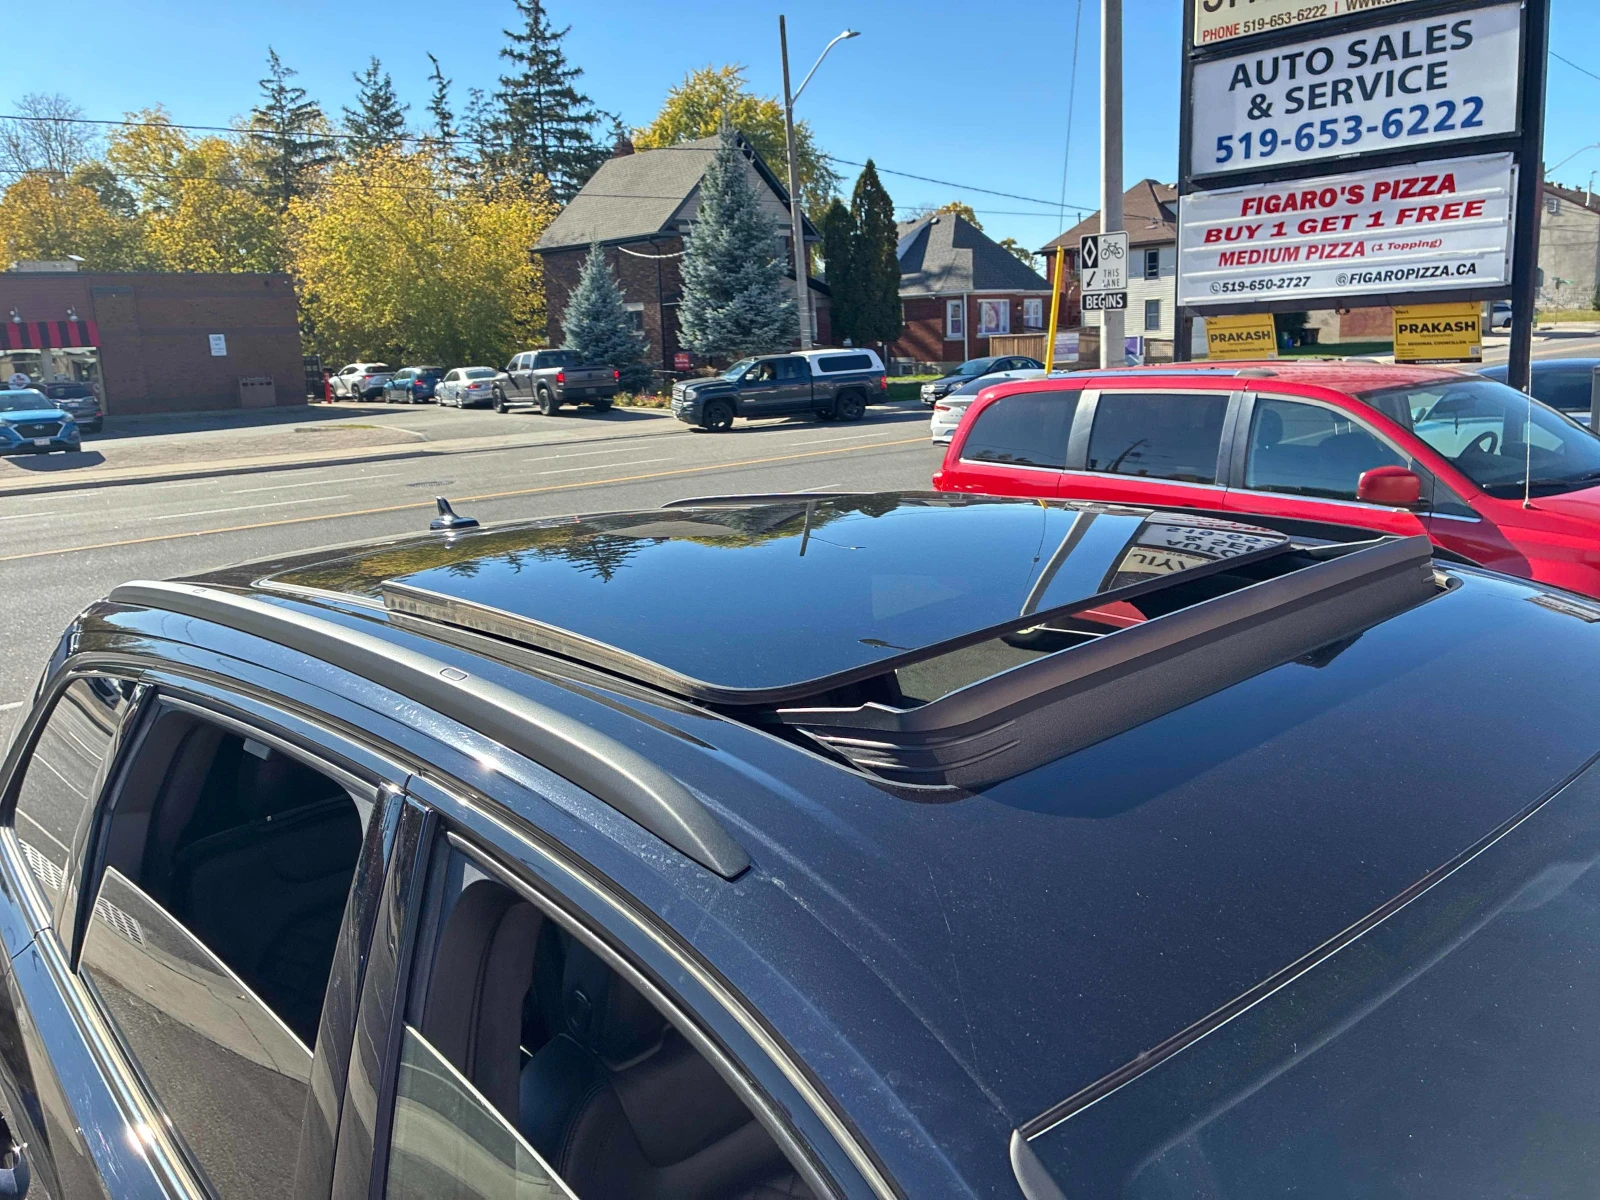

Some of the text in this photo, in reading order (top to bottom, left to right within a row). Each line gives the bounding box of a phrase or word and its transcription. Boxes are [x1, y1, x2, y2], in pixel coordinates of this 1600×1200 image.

[1202, 23, 1240, 42] PHONE
[1243, 4, 1327, 33] 519-653-6222
[1228, 20, 1473, 91] AUTO SALES
[1247, 60, 1448, 120] & SERVICE
[1215, 96, 1484, 163] 519-653-6222
[1241, 173, 1456, 216] FIGARO'S PIZZA
[1204, 199, 1486, 244] BUY 1 GET 1 FREE
[1218, 245, 1300, 267] MEDIUM
[1305, 240, 1365, 260] PIZZA
[1387, 239, 1442, 251] Topping)
[1103, 268, 1119, 278] THIS
[1221, 276, 1311, 293] 519-650-2727
[1086, 294, 1123, 309] BEGINS
[1210, 330, 1271, 343] PRAKASH
[1398, 321, 1476, 334] PRAKASH
